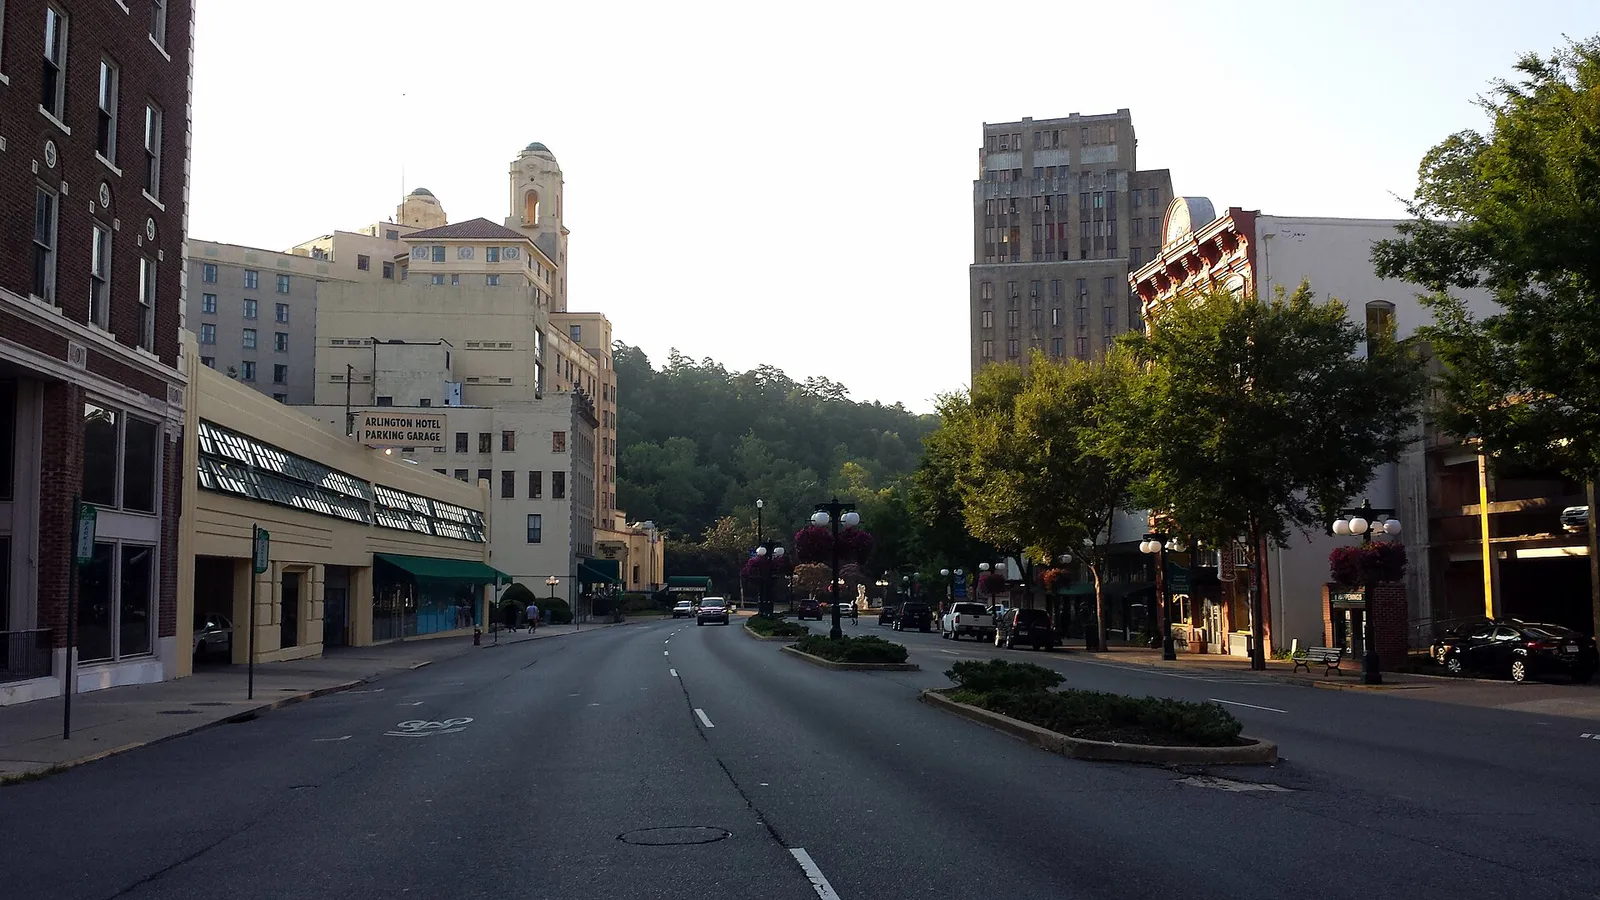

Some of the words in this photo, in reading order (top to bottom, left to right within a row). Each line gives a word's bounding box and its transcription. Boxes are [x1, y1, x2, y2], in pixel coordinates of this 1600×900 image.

[365, 417, 412, 428] ARLINGTON
[416, 419, 441, 429] HOTEL
[365, 430, 404, 440] PARKING
[407, 431, 441, 441] GARAGE
[82, 505, 88, 513] 2
[82, 521, 90, 556] PARKING
